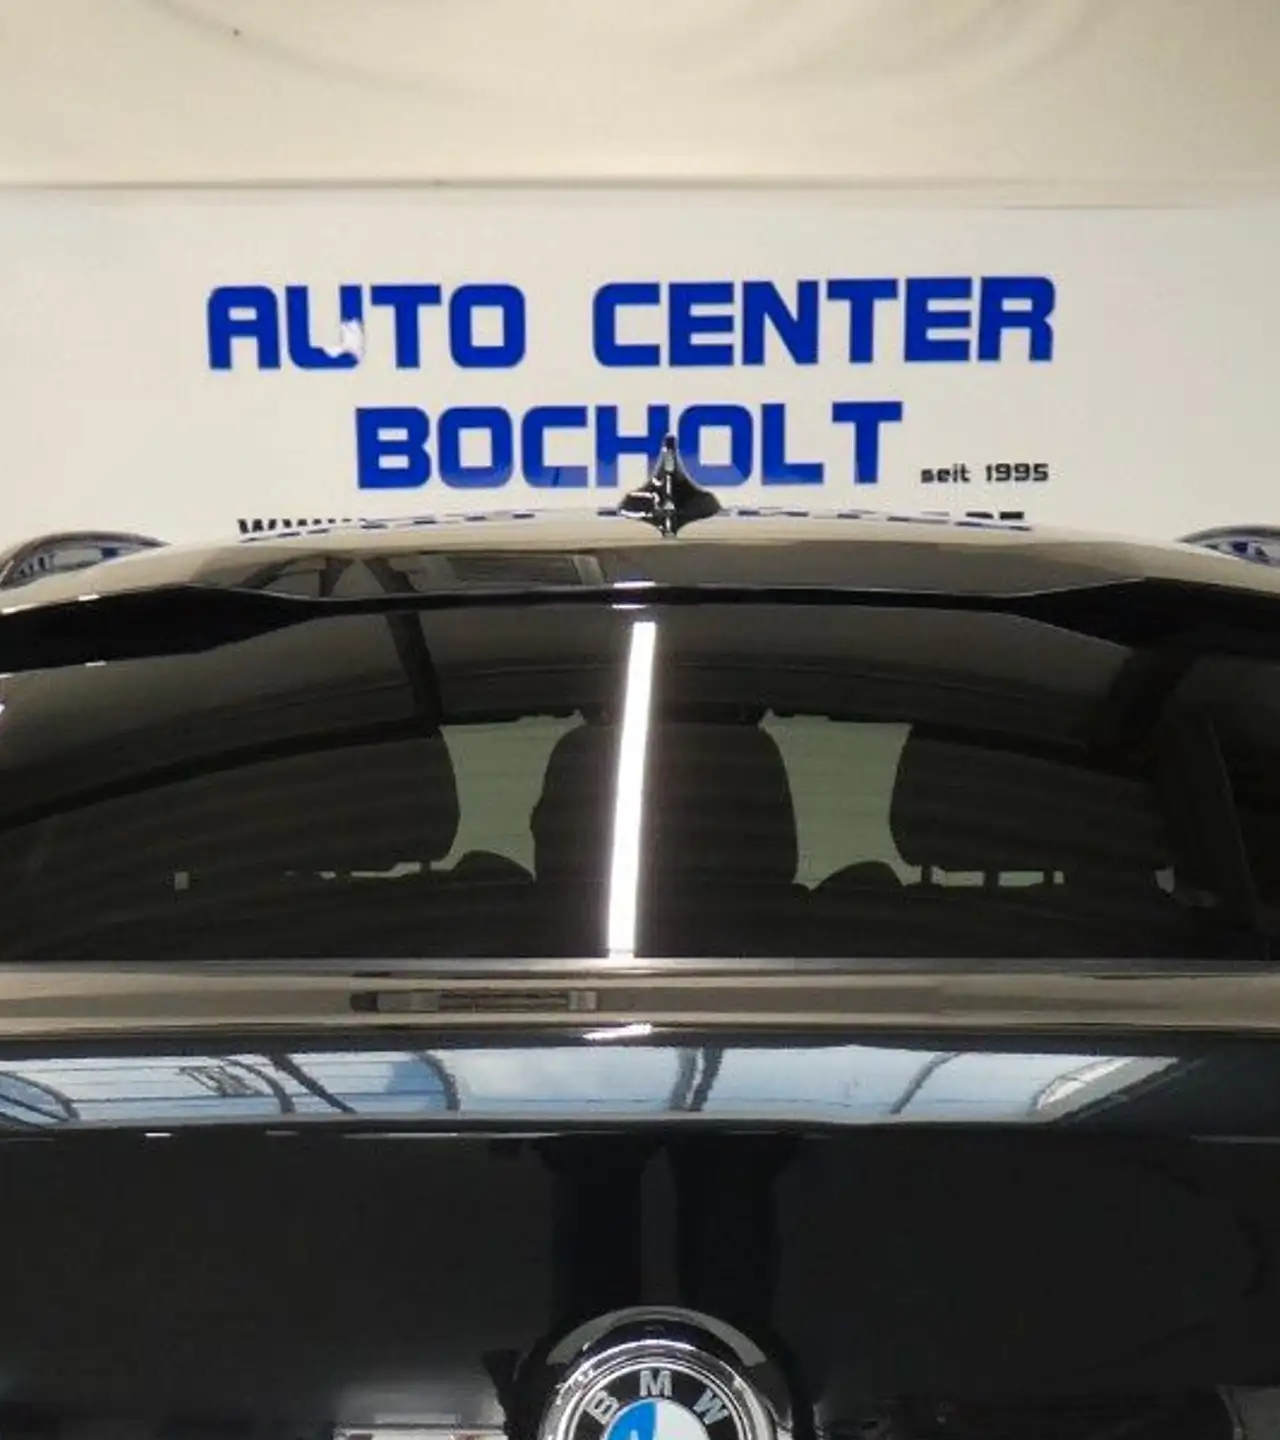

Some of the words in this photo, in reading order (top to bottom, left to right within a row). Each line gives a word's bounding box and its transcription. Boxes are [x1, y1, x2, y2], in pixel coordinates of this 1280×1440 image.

[207, 283, 527, 370] AUTO
[593, 276, 1056, 368] CENTER
[356, 401, 903, 490] BOCHOLT
[920, 463, 971, 484] seit
[985, 462, 1050, 483] 1995
[583, 1369, 729, 1425] BMW
